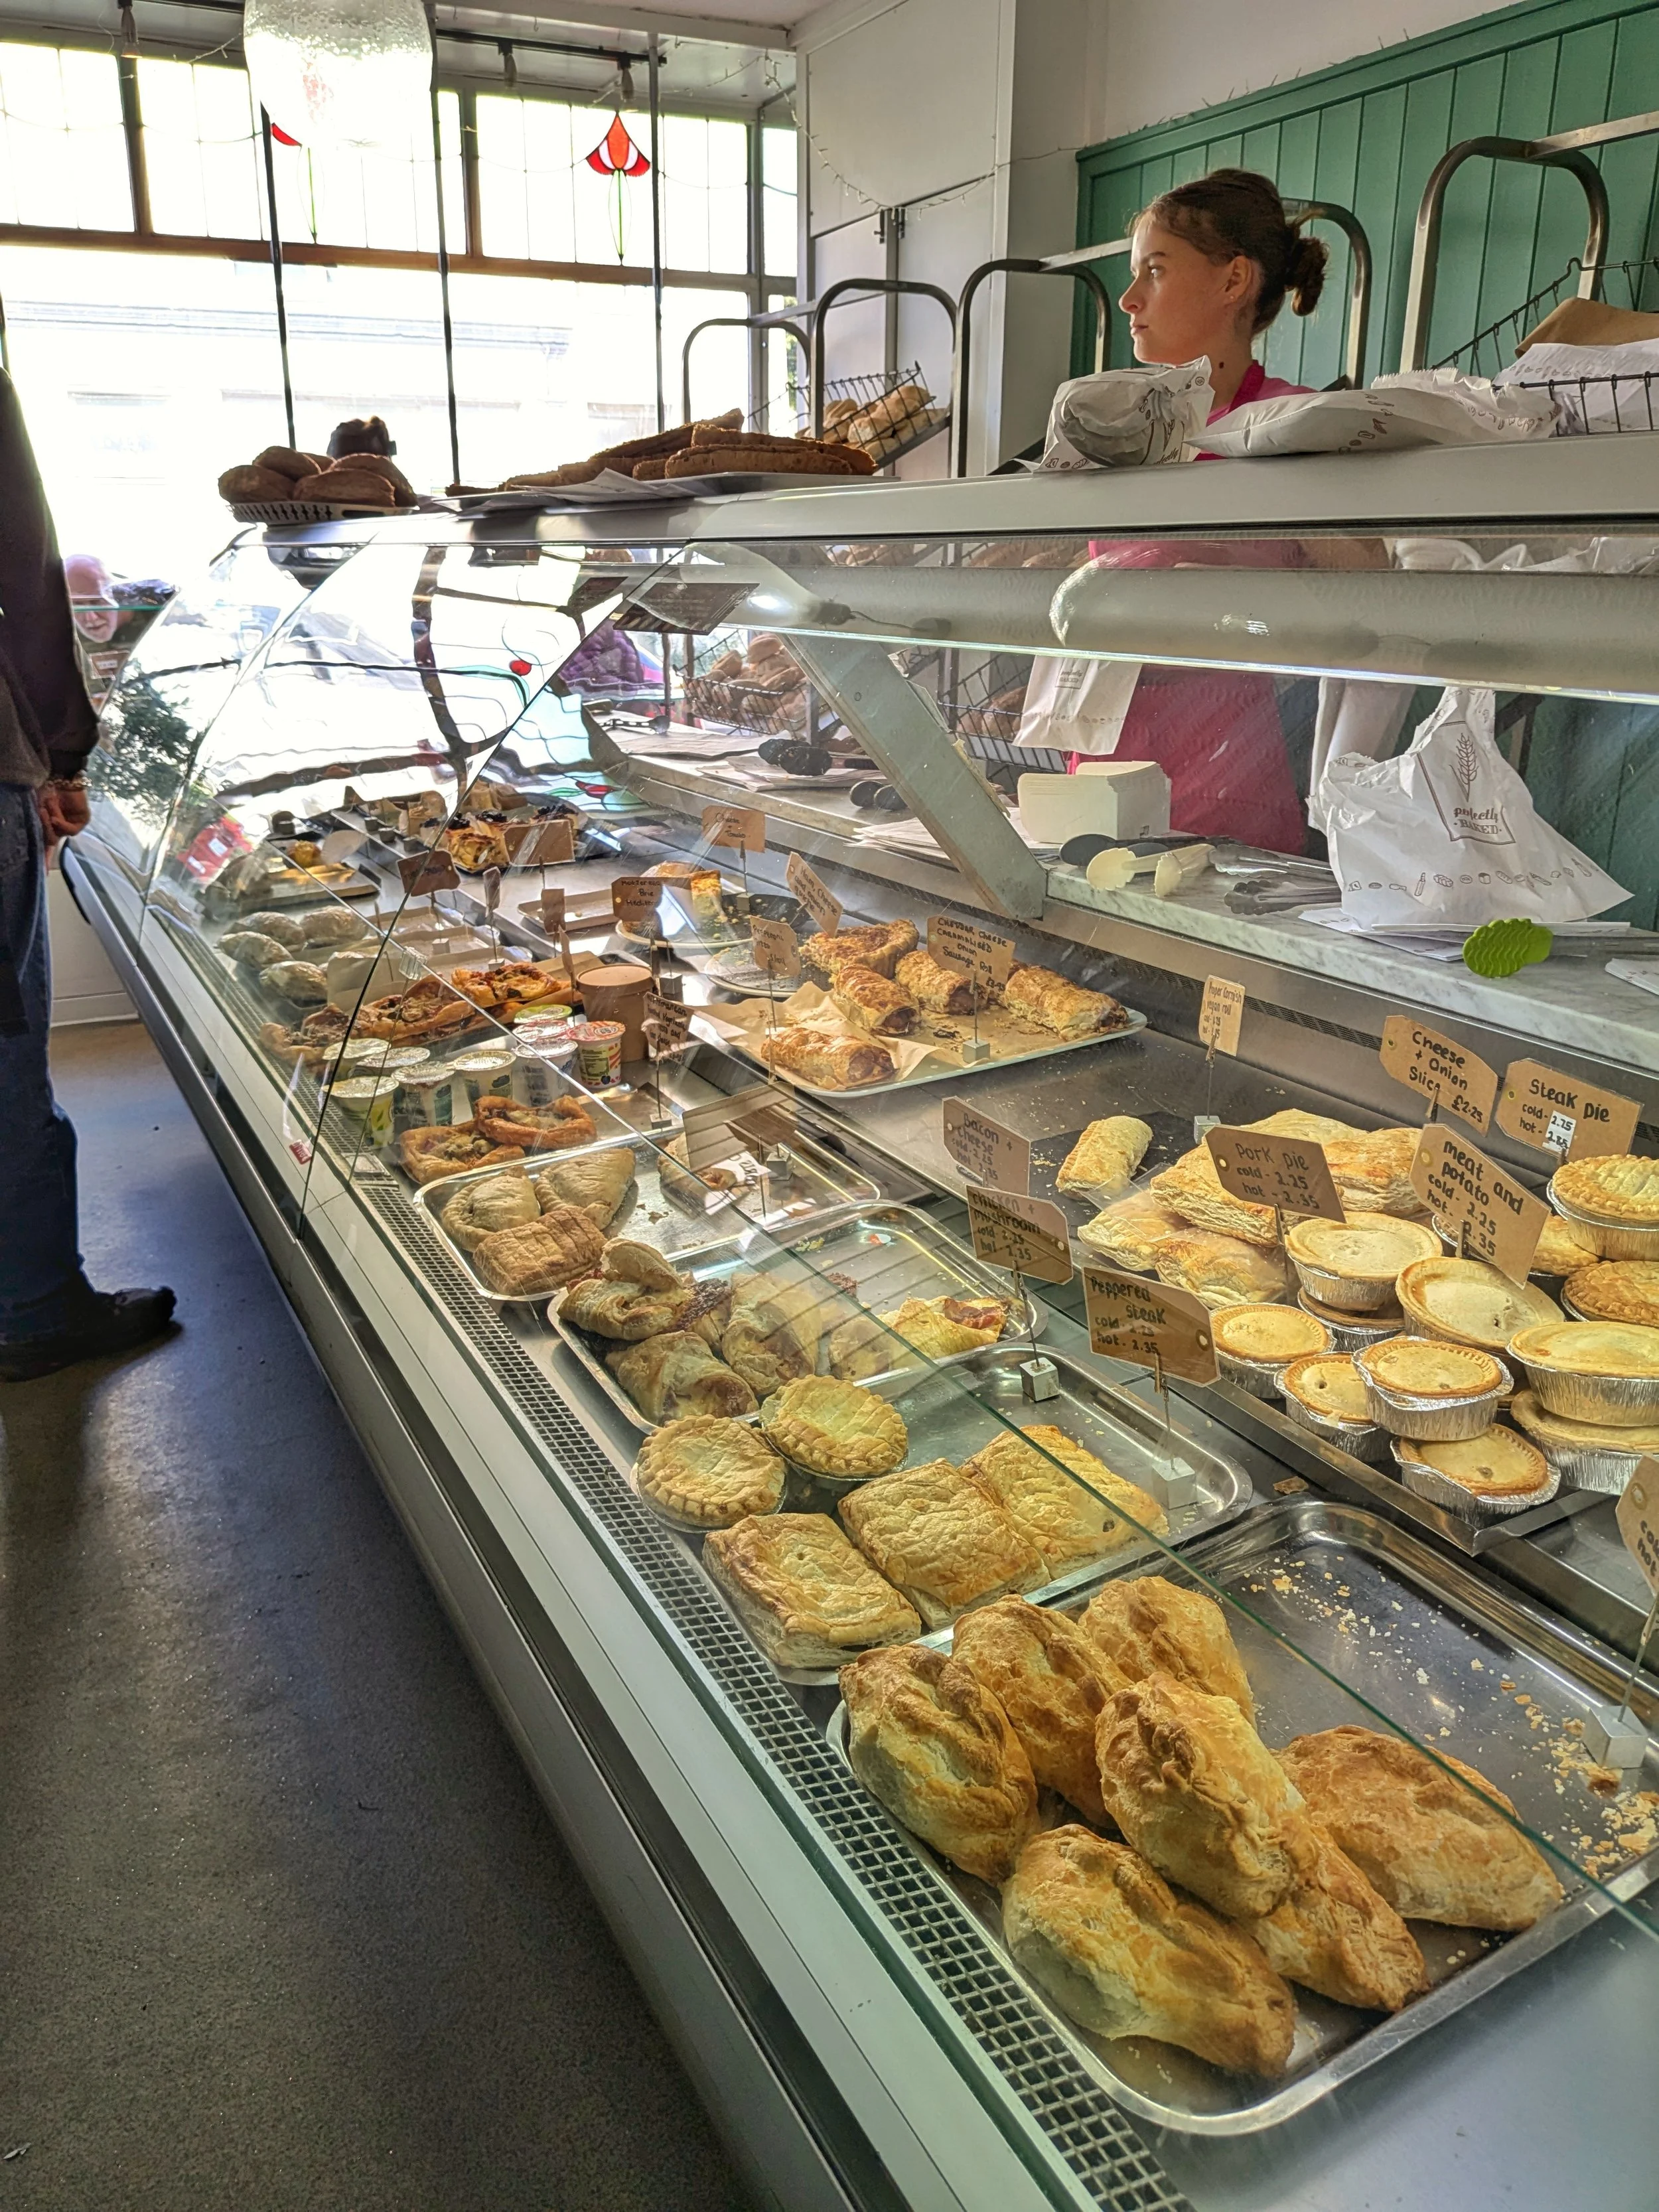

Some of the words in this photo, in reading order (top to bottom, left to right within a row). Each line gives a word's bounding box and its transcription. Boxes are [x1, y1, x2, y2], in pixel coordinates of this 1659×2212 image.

[1412, 1031, 1465, 1069] Cheese
[1409, 1066, 1441, 1092] Slice
[1429, 1058, 1468, 1090] Onion
[1451, 1094, 1483, 1123] £2.25
[1528, 1078, 1578, 1110] Steak
[964, 1113, 999, 1145] Bacon
[1551, 1115, 1573, 1132] 2.75
[1235, 1142, 1275, 1163] Pork
[1282, 1150, 1309, 1171] pie
[1242, 1181, 1266, 1198] hot
[1282, 1191, 1321, 1209] 2.35
[1274, 1171, 1309, 1190] 2.25
[1441, 1161, 1490, 1206] potato
[1493, 1181, 1524, 1215] and
[1467, 1201, 1497, 1236] 2.25
[1637, 1537, 1657, 1578] hot
